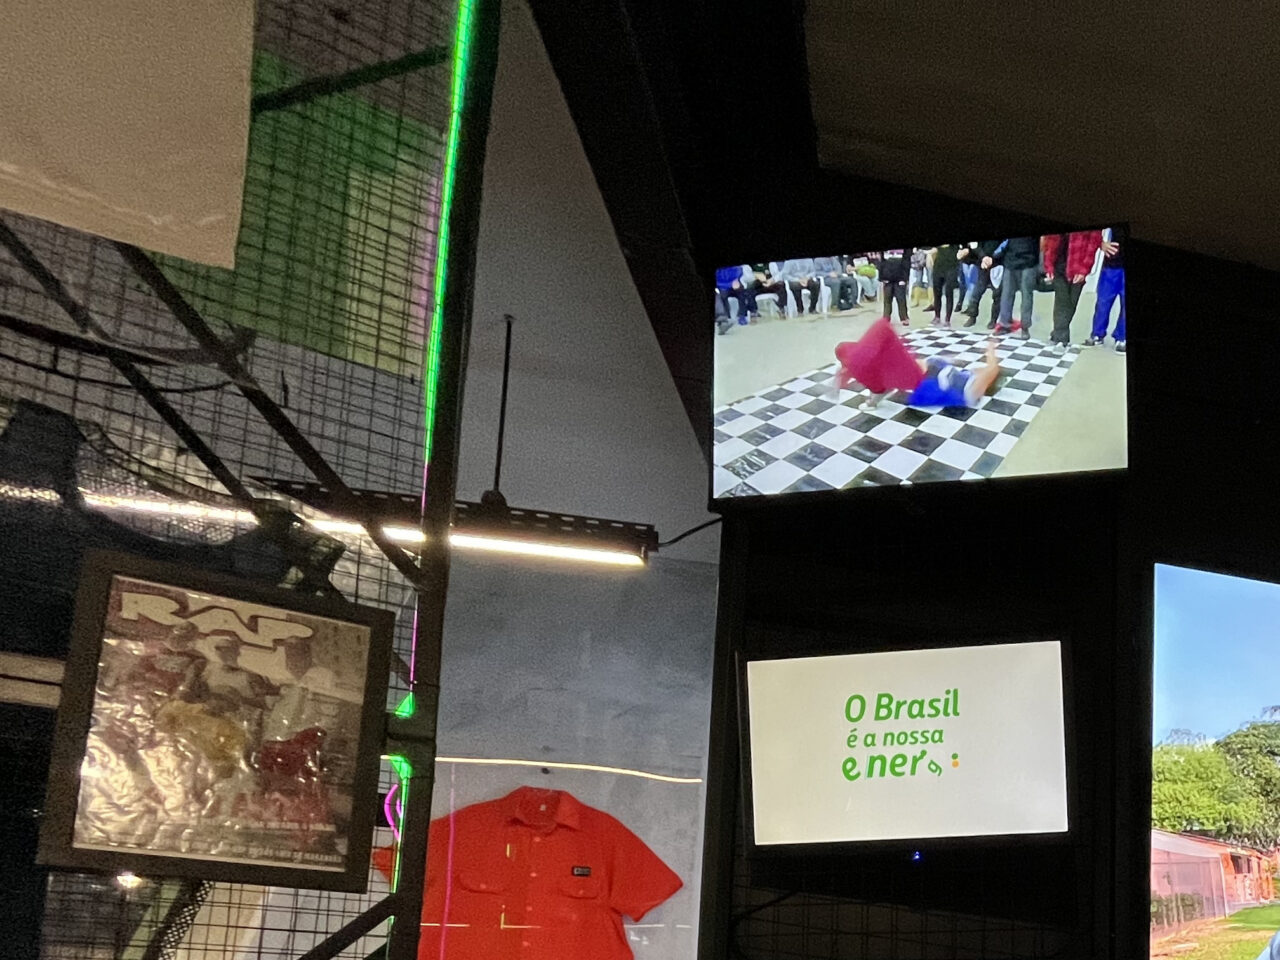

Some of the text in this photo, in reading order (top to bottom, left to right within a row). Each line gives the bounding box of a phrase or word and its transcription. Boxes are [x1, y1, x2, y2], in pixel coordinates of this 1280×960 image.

[845, 688, 960, 723] O Brasil
[847, 727, 944, 748] é a nossa
